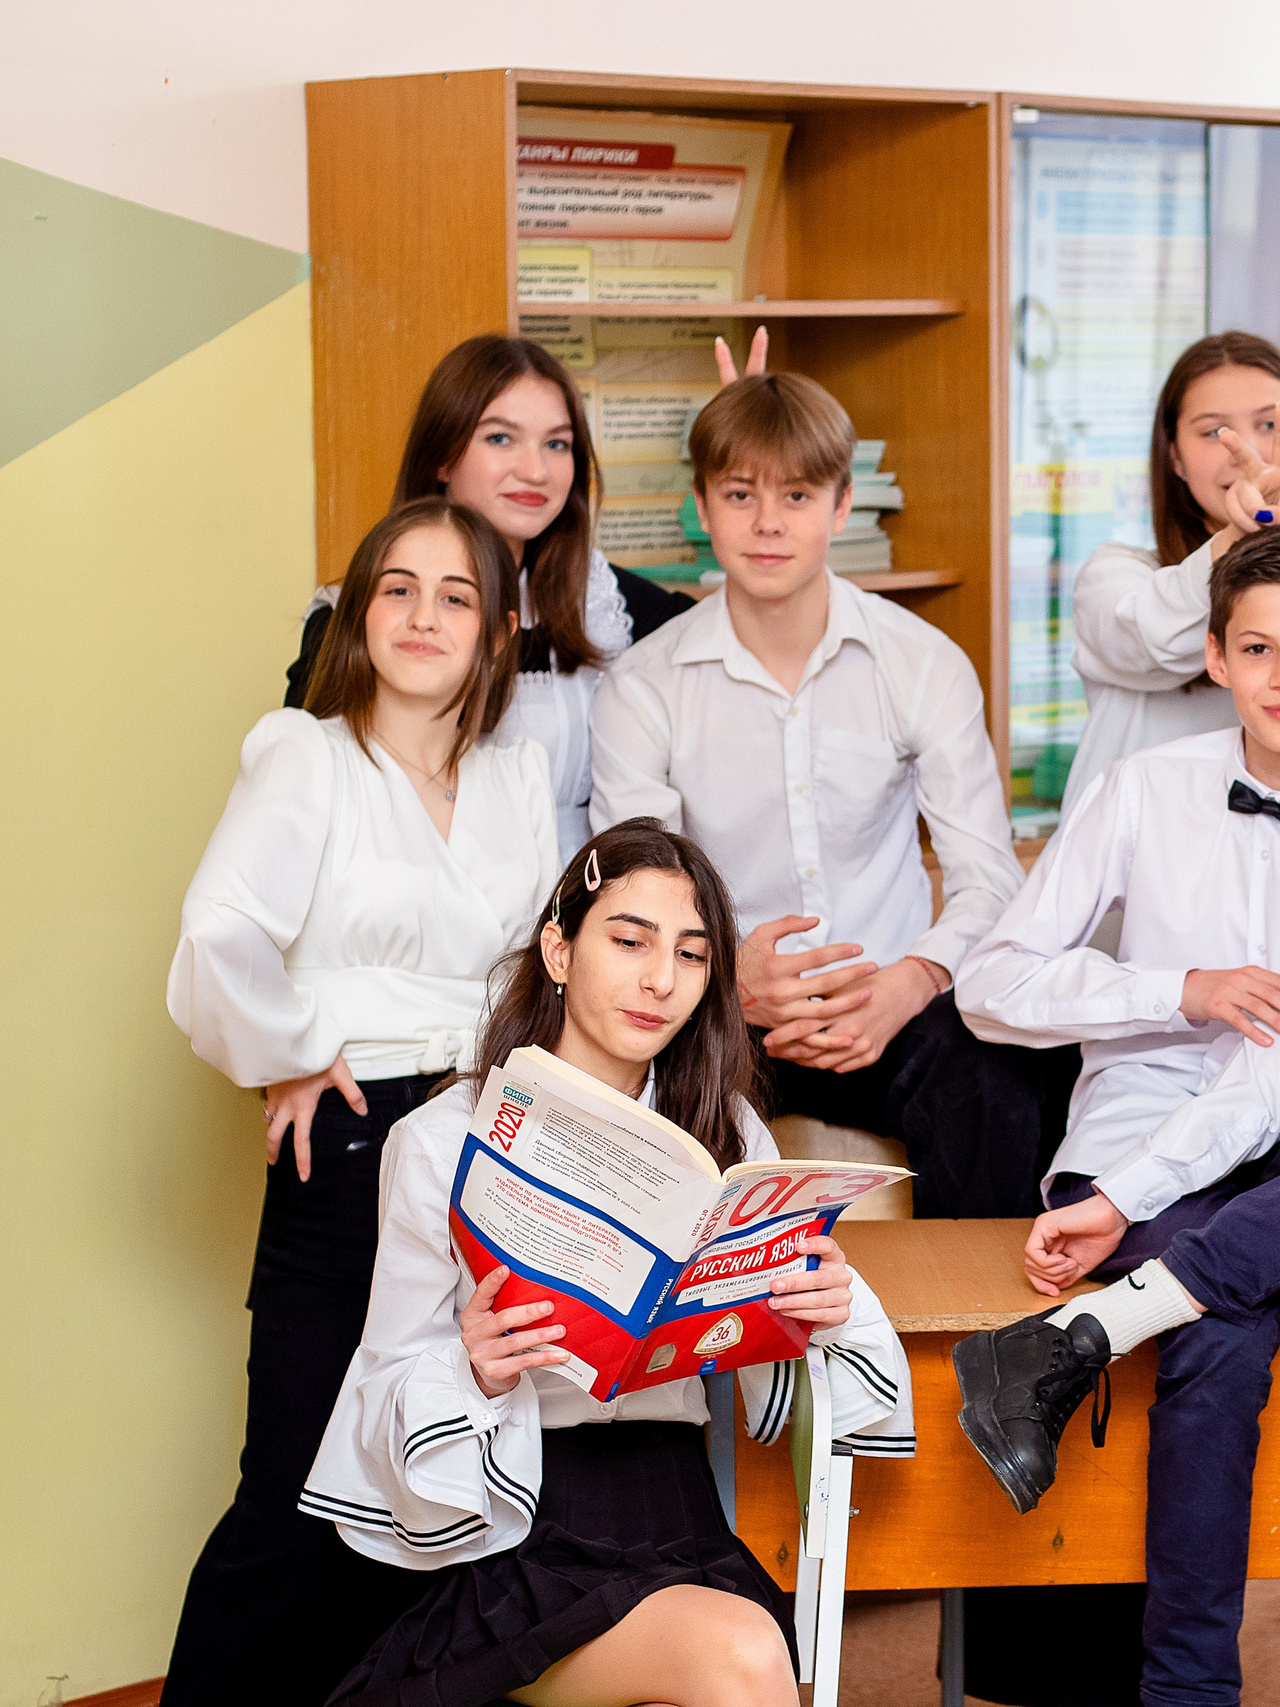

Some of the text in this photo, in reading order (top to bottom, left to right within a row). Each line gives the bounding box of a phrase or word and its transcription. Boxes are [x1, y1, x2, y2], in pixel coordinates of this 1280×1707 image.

[571, 146, 639, 164] ЛИРИКИ
[504, 1088, 532, 1104] ФИПИ
[489, 1102, 526, 1153] 2020
[494, 1176, 534, 1204] ИЗДАТЕЛЬСТВА
[729, 1173, 888, 1226] ОГЭ
[496, 1183, 506, 1193] ЭТО
[506, 1190, 530, 1208] СИСТЕМА
[570, 1226, 607, 1246] ПОДГОТОВКИ
[612, 1246, 623, 1256] ОГЭ
[506, 1177, 524, 1191] КНИГИ
[524, 1189, 533, 1197] ПО
[533, 1194, 561, 1211] РУССКОМУ
[587, 1221, 621, 1242] ЛИТЕРАТУРЕ
[691, 1209, 709, 1237] ОГЭ 2020
[734, 1223, 787, 1248] ГОСУДАРСТВЕННЫЙ
[787, 1215, 814, 1227] ЭКЗАМЕН
[685, 1263, 802, 1297] ТИПОВЫЕ ЭКЗАМЕНАЦИОННЫЕ ВАРИАНТЫ
[690, 1245, 766, 1282] РУССКИЙ
[646, 1278, 674, 1324] РУССКИЙ ЯЗЫК
[712, 1324, 731, 1342] 36
